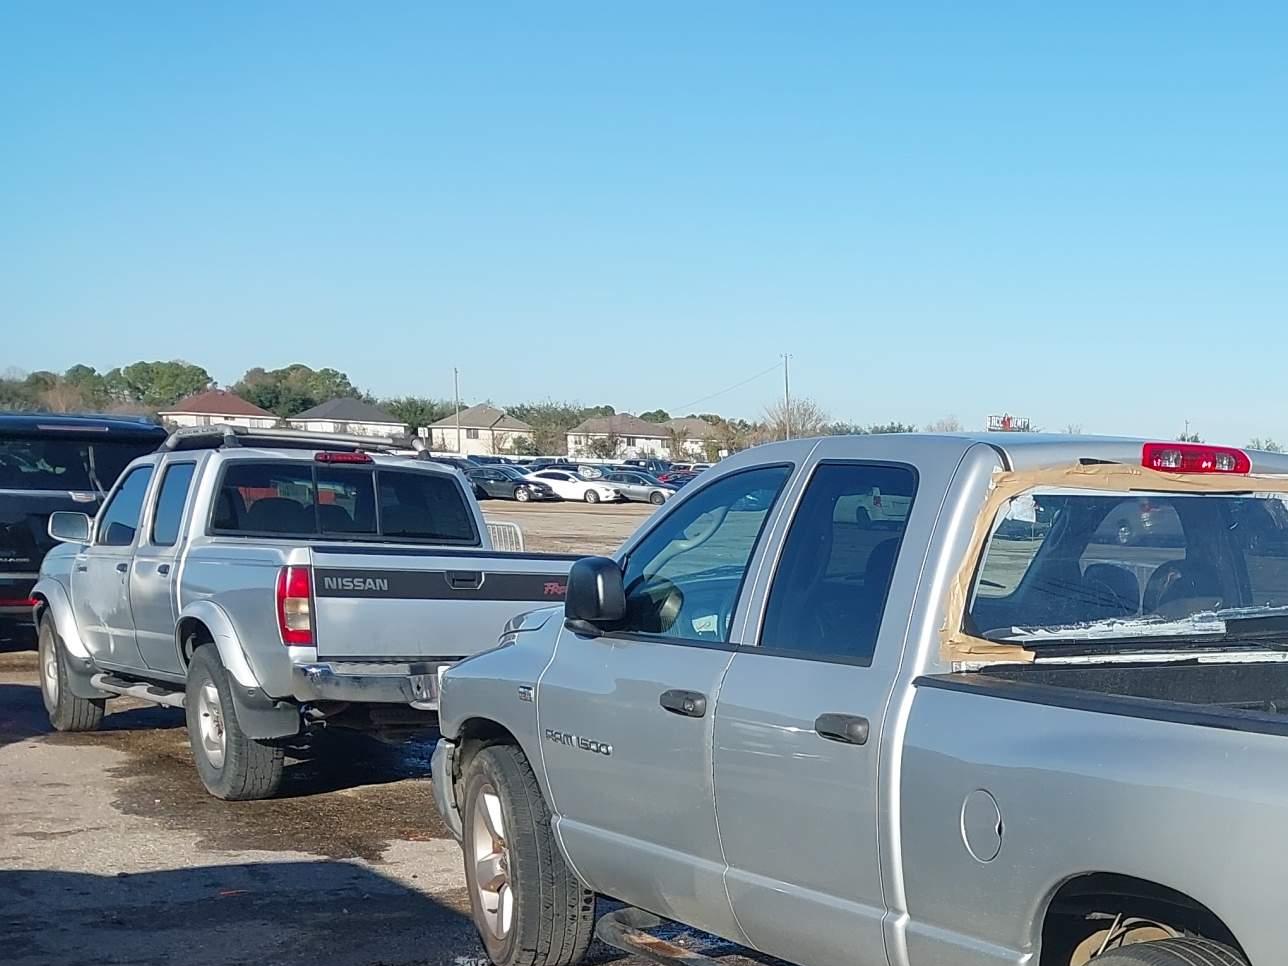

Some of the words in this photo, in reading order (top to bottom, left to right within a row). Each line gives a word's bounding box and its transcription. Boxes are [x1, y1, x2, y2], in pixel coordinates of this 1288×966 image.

[323, 576, 389, 591] NISSAN
[545, 728, 577, 748] RAM
[576, 736, 613, 756] 1500
